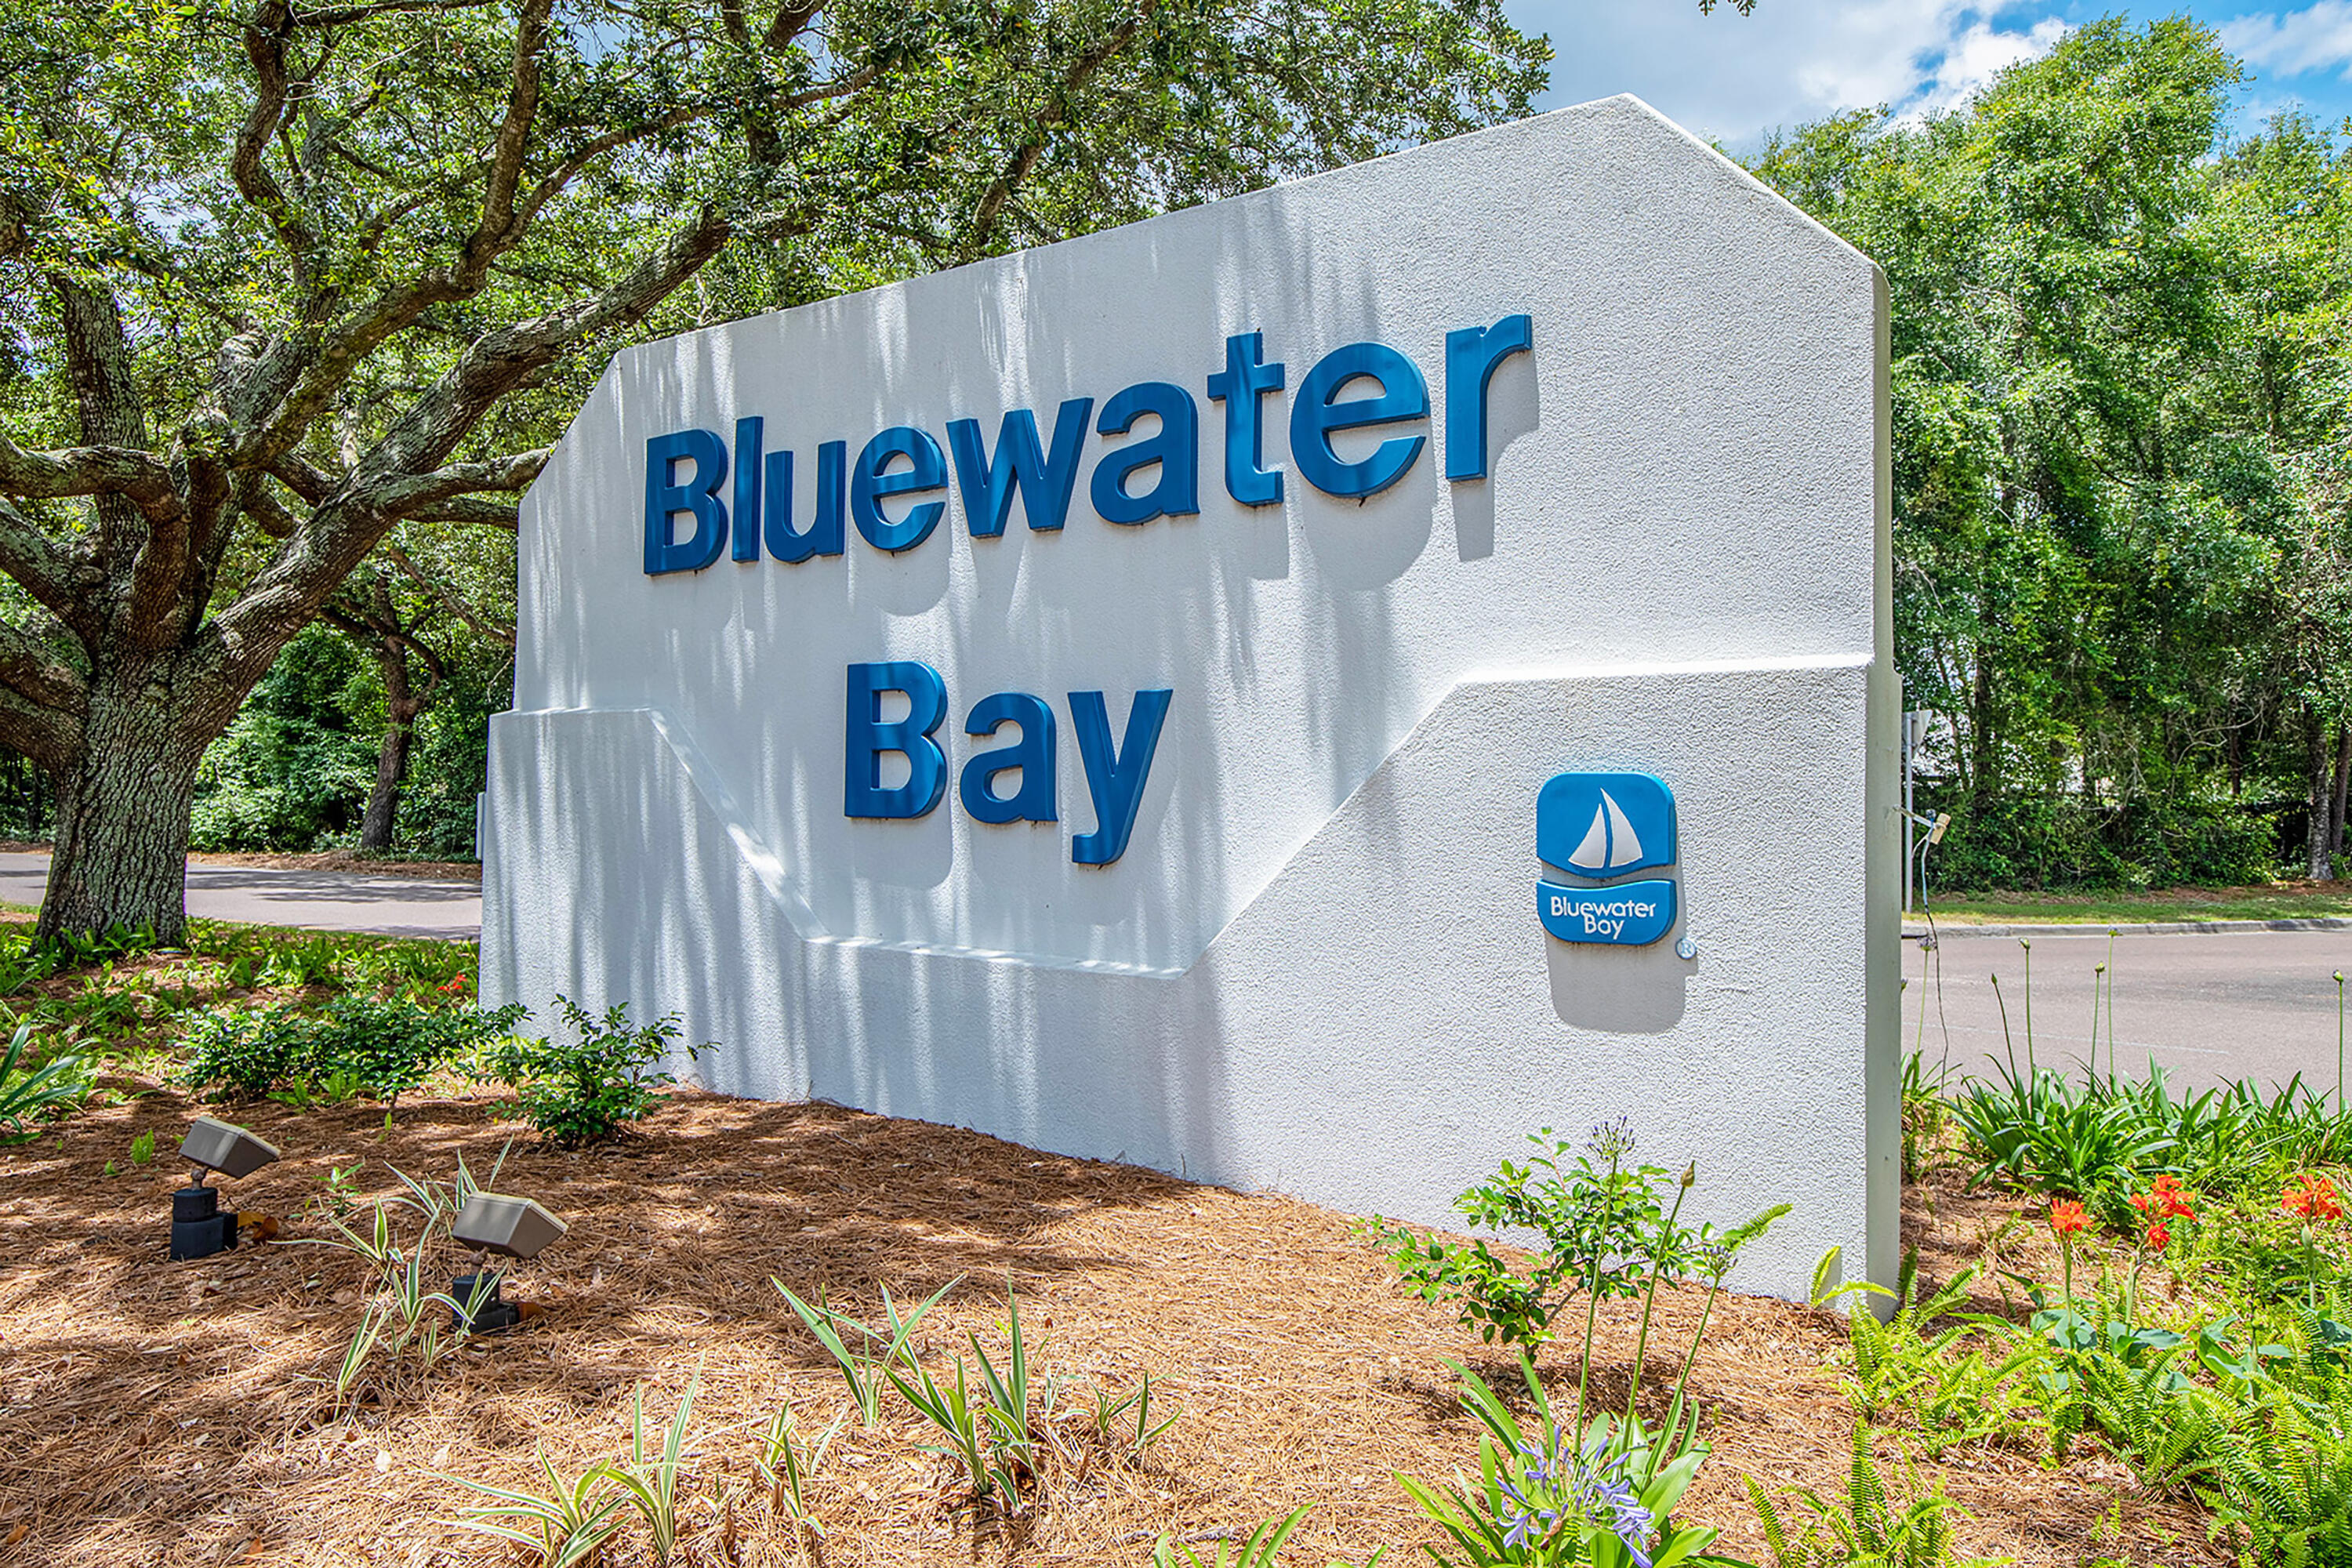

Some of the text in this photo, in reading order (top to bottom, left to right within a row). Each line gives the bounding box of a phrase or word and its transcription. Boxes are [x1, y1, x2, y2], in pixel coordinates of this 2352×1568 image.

[644, 314, 1533, 575] Bluewater
[844, 660, 1174, 866] Bay
[1550, 896, 1656, 917] Bluewater
[1584, 913, 1624, 940] Bay
